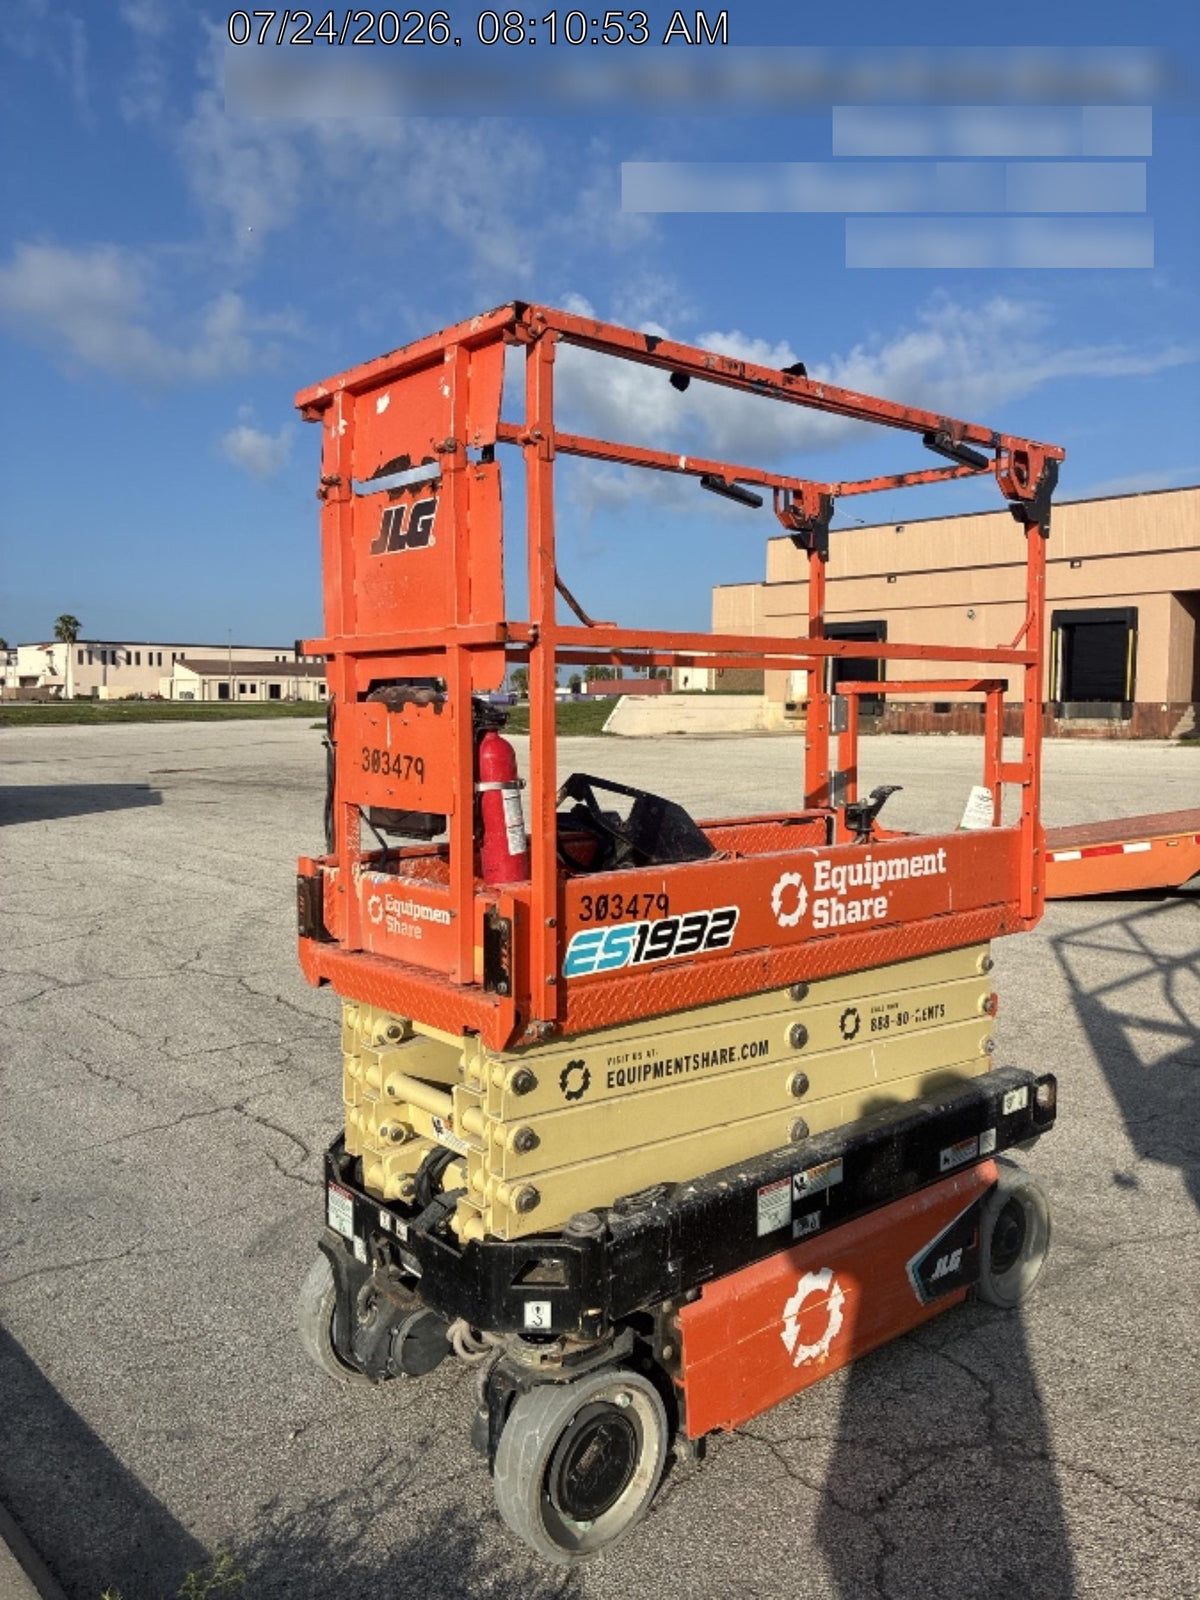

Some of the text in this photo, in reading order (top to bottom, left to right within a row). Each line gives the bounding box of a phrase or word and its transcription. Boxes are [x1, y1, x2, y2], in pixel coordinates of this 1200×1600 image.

[370, 496, 439, 556] JLG
[361, 746, 425, 784] 303479
[813, 847, 948, 892] Equipment
[384, 893, 452, 926] Equipmen
[386, 913, 423, 940] Share
[578, 893, 670, 923] 303479
[811, 894, 888, 930] Share
[562, 905, 740, 979] ES1932
[606, 1039, 770, 1089] EQUIPMENTSHARE.COM
